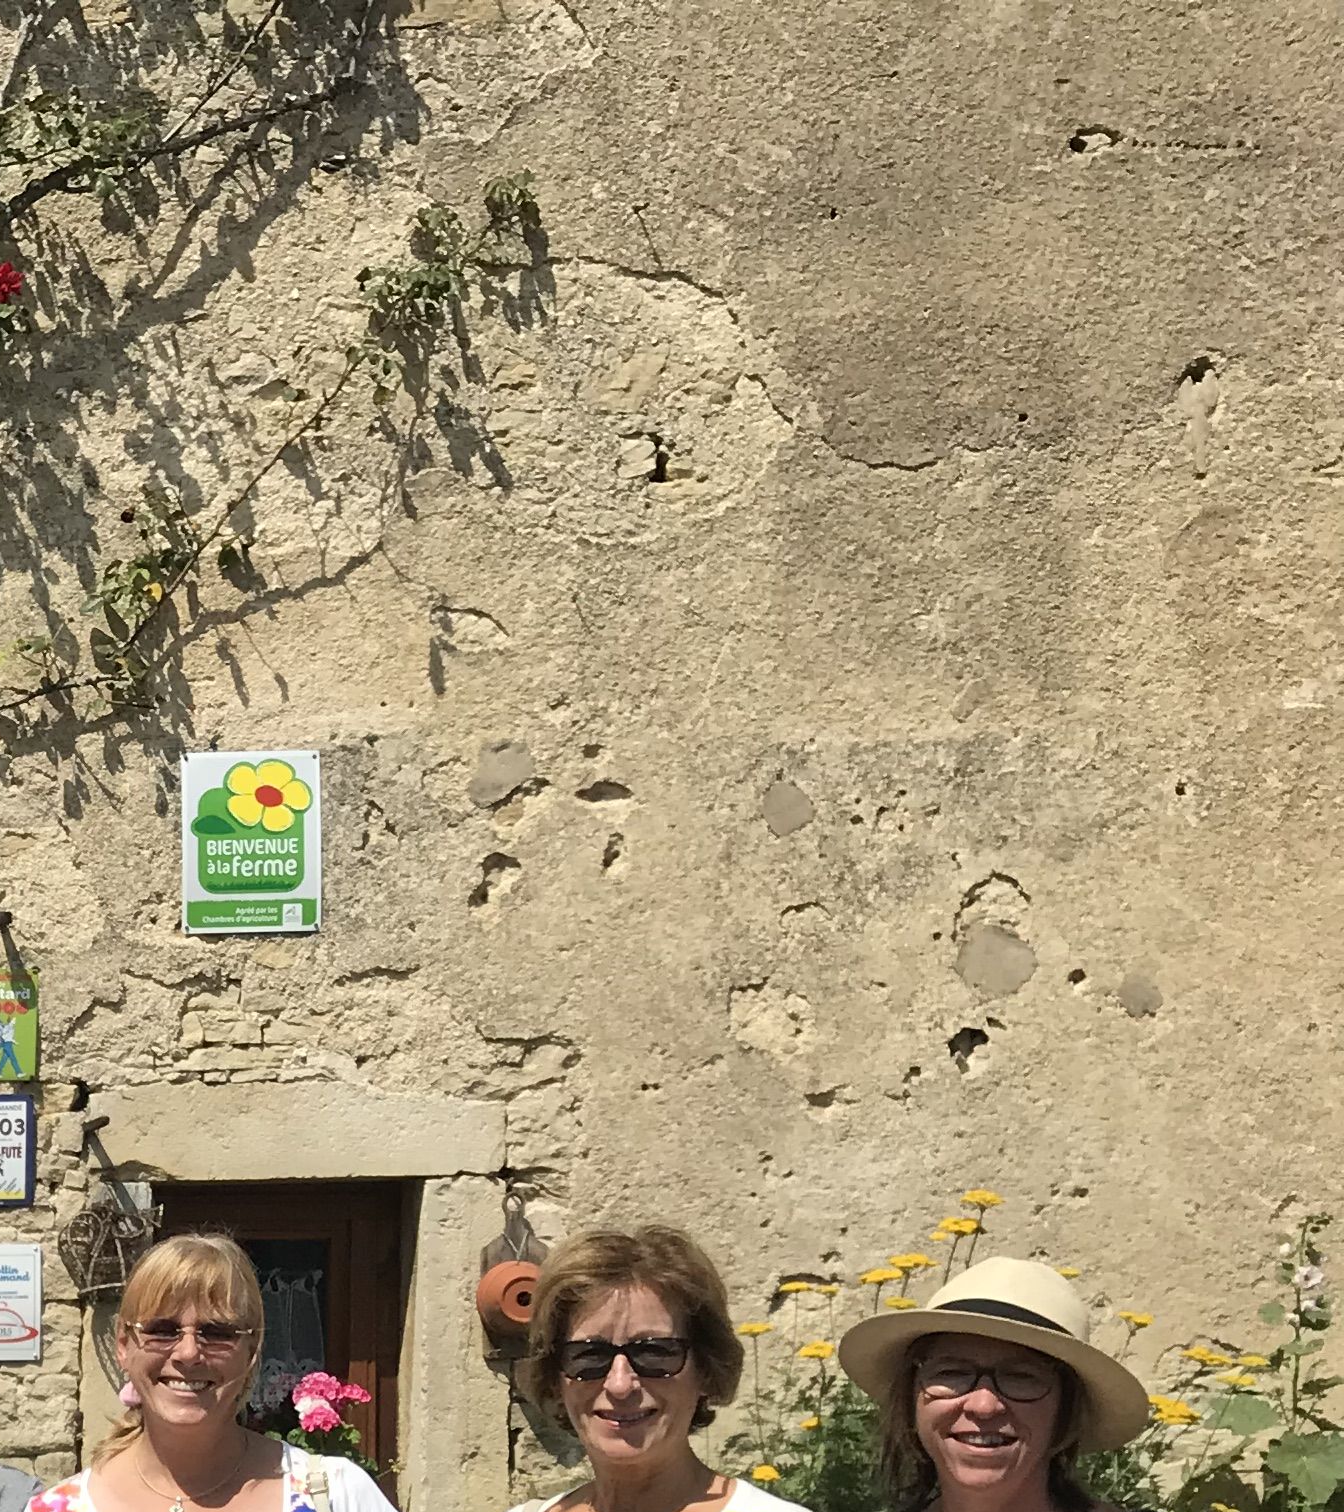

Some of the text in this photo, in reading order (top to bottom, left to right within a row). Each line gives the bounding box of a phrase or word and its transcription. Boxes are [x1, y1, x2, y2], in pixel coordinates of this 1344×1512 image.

[206, 838, 299, 856] BIENVENUE
[207, 855, 298, 877] à la ferme
